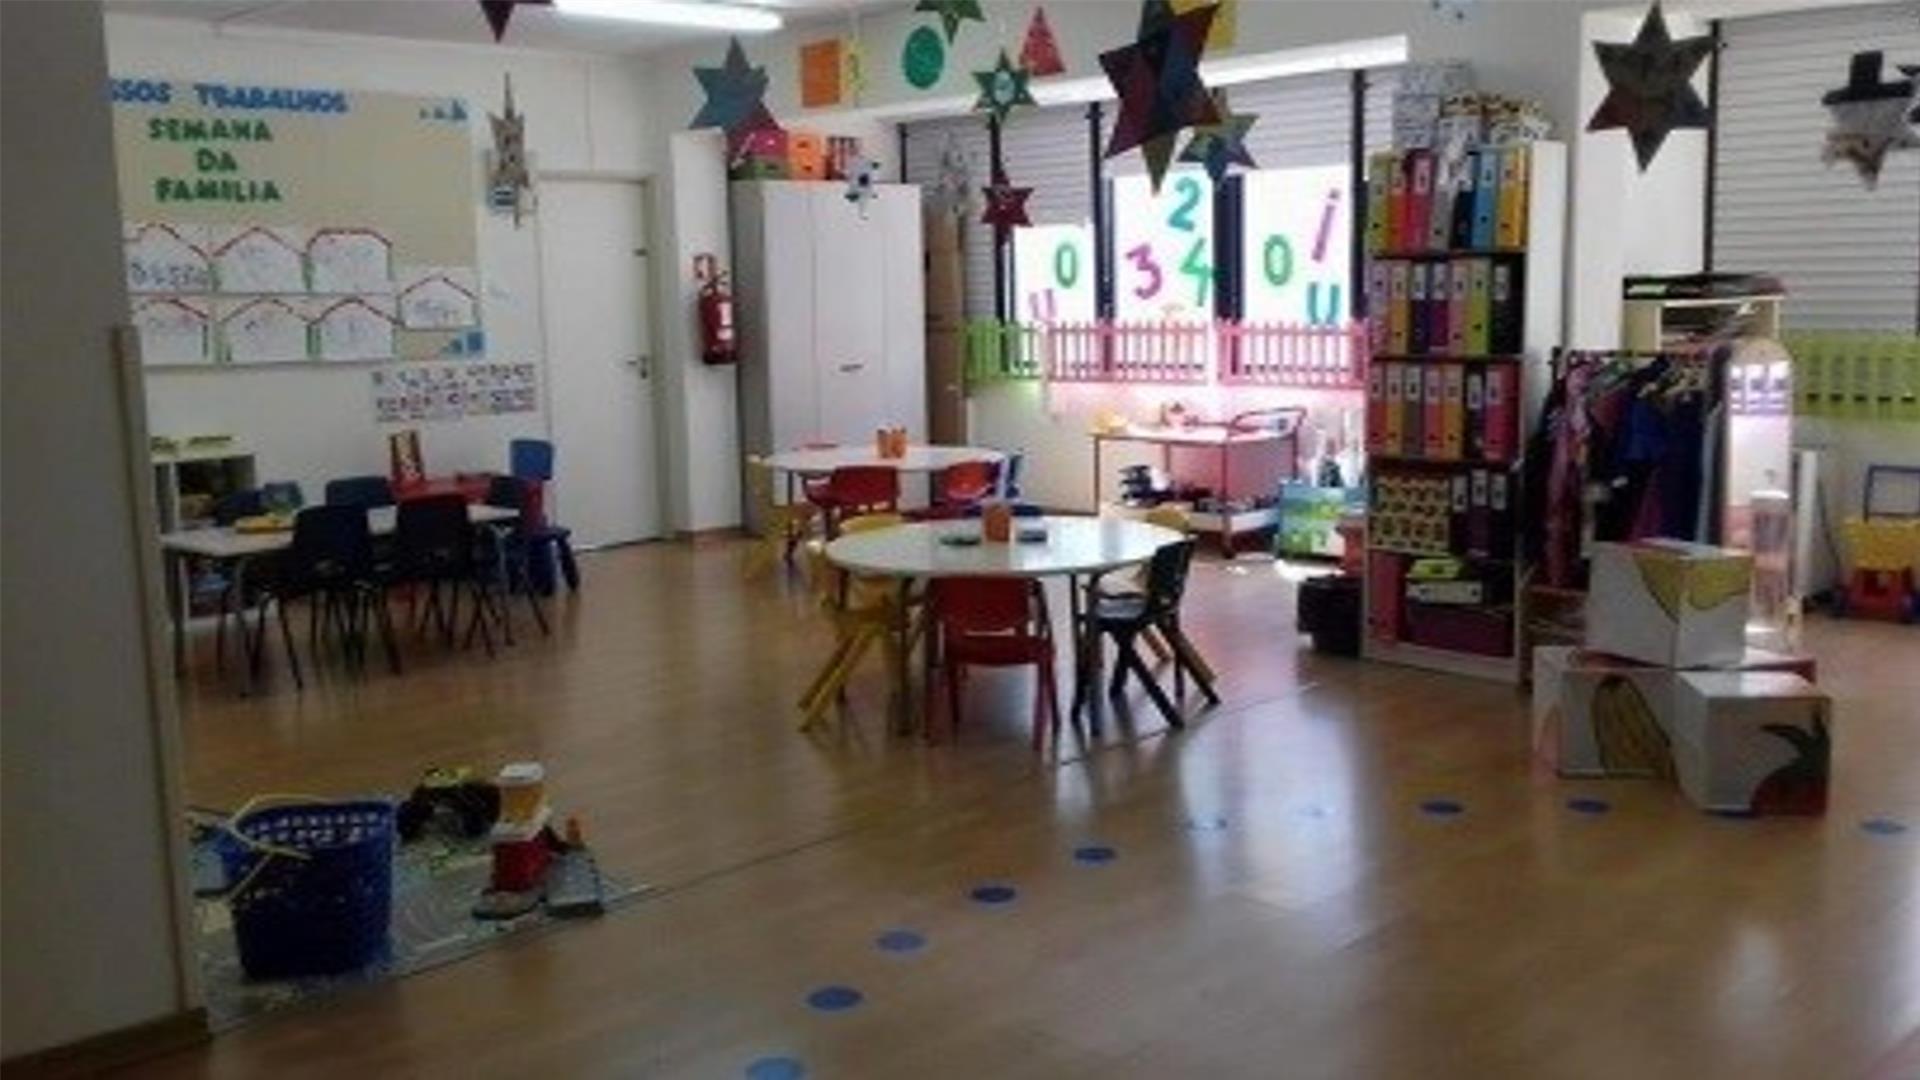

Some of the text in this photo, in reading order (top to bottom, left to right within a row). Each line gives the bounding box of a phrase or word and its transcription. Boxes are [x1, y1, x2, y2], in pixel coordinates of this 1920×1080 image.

[194, 83, 348, 113] TRABALHOS
[149, 118, 273, 142] SEMANA
[196, 147, 237, 172] DA
[155, 176, 282, 203] FAMILIA
[1169, 176, 1202, 232] 2
[1126, 244, 1163, 300] 3
[1179, 237, 1218, 307] 4
